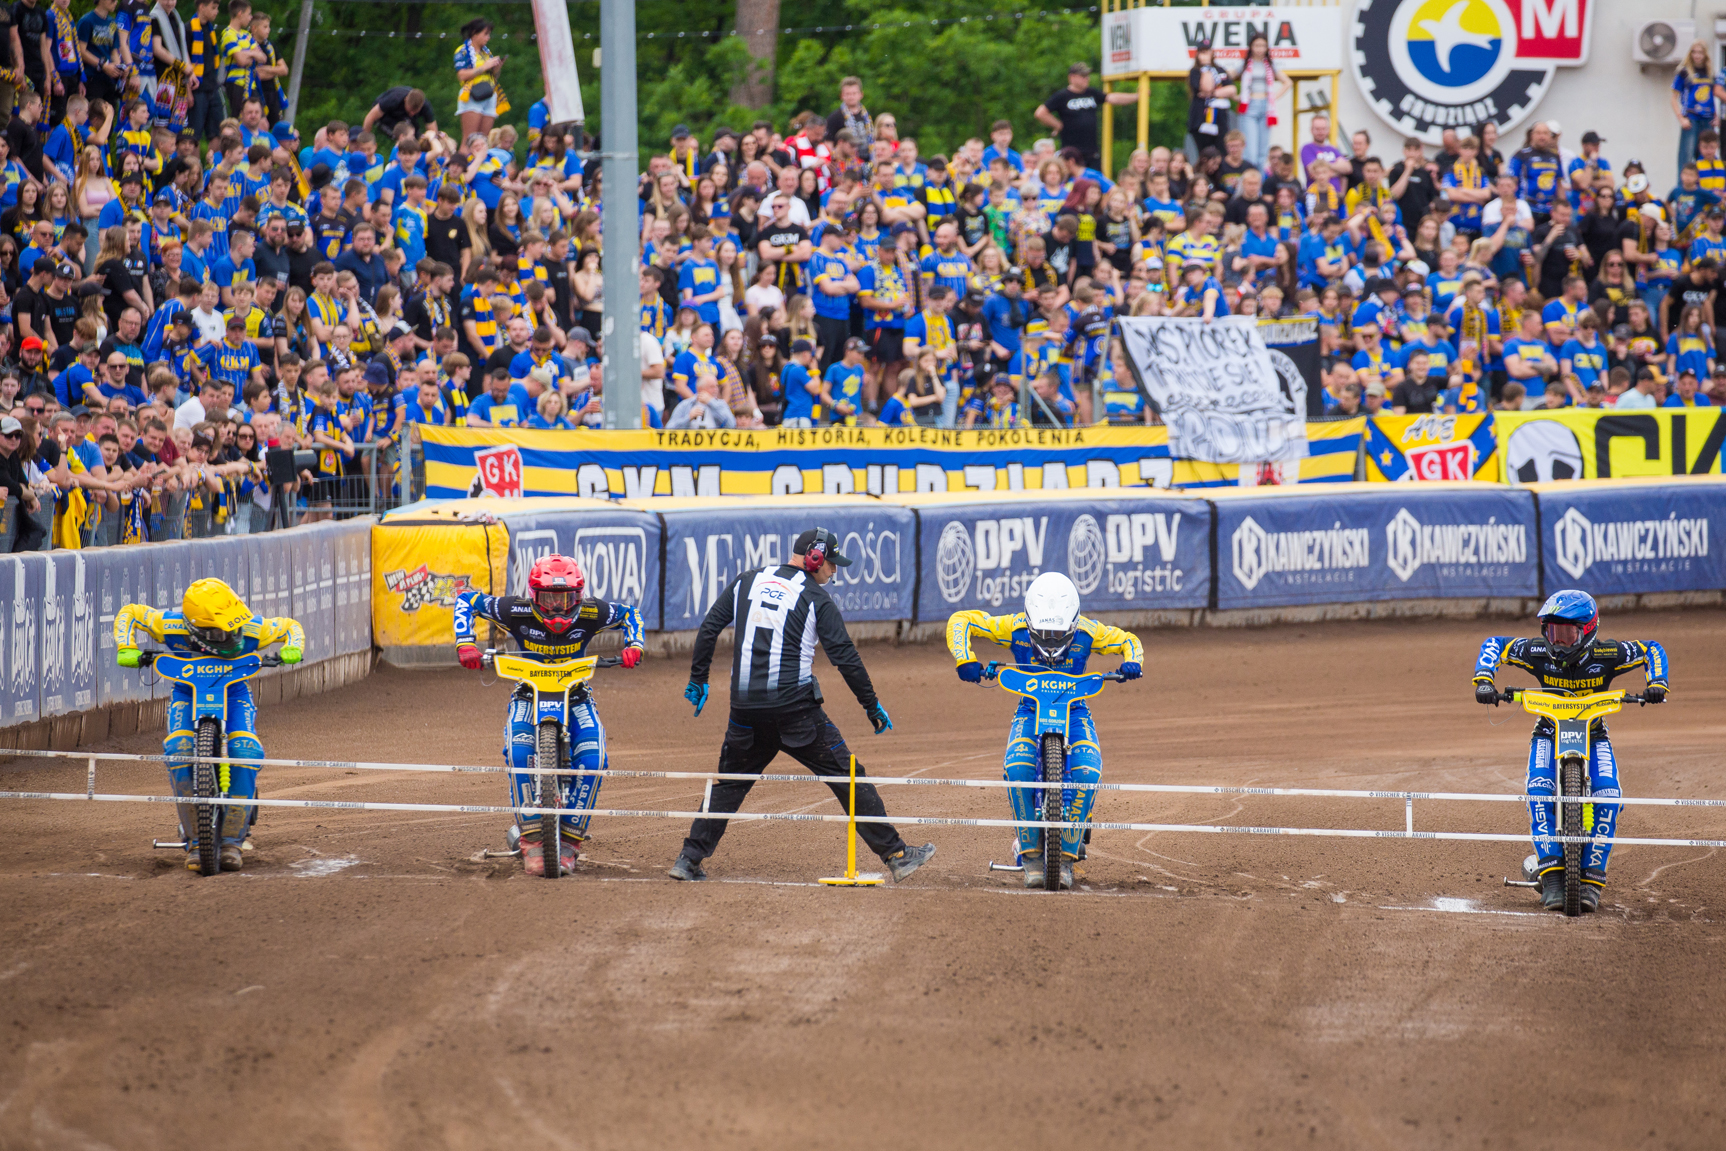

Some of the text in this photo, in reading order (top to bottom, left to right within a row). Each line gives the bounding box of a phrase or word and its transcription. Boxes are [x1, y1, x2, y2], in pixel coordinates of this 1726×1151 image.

[1203, 10, 1275, 19] GRUPA
[1521, 0, 1579, 39] M
[1182, 21, 1297, 46] WENA
[777, 429, 871, 445] HISTORIA,
[884, 428, 963, 446] KOLEJNE
[977, 430, 1085, 447] POKOLENIA
[975, 516, 1048, 570] DPV
[1106, 513, 1182, 563] DPV
[1421, 516, 1527, 563] KAWCZYŃSKI
[1593, 511, 1709, 562] KAWCZYŃSKI
[1267, 521, 1370, 572] KAWCZYŃSKI
[1611, 559, 1691, 574] INSTALACJE
[1106, 563, 1184, 600] logistic
[760, 587, 787, 601] PGE
[227, 612, 252, 629] BOLL
[953, 622, 965, 660] KASKAT
[197, 664, 234, 674] KGHM
[529, 669, 573, 678] BAYERSYSTEM
[1041, 679, 1077, 691] KGHM
[1552, 703, 1592, 711] BAYERSYSTEM
[1560, 731, 1583, 739] DPV
[310, 801, 365, 809] VISSCHER-CARAVELLE
[923, 818, 978, 826] VISSCHER-CARAVELLE
